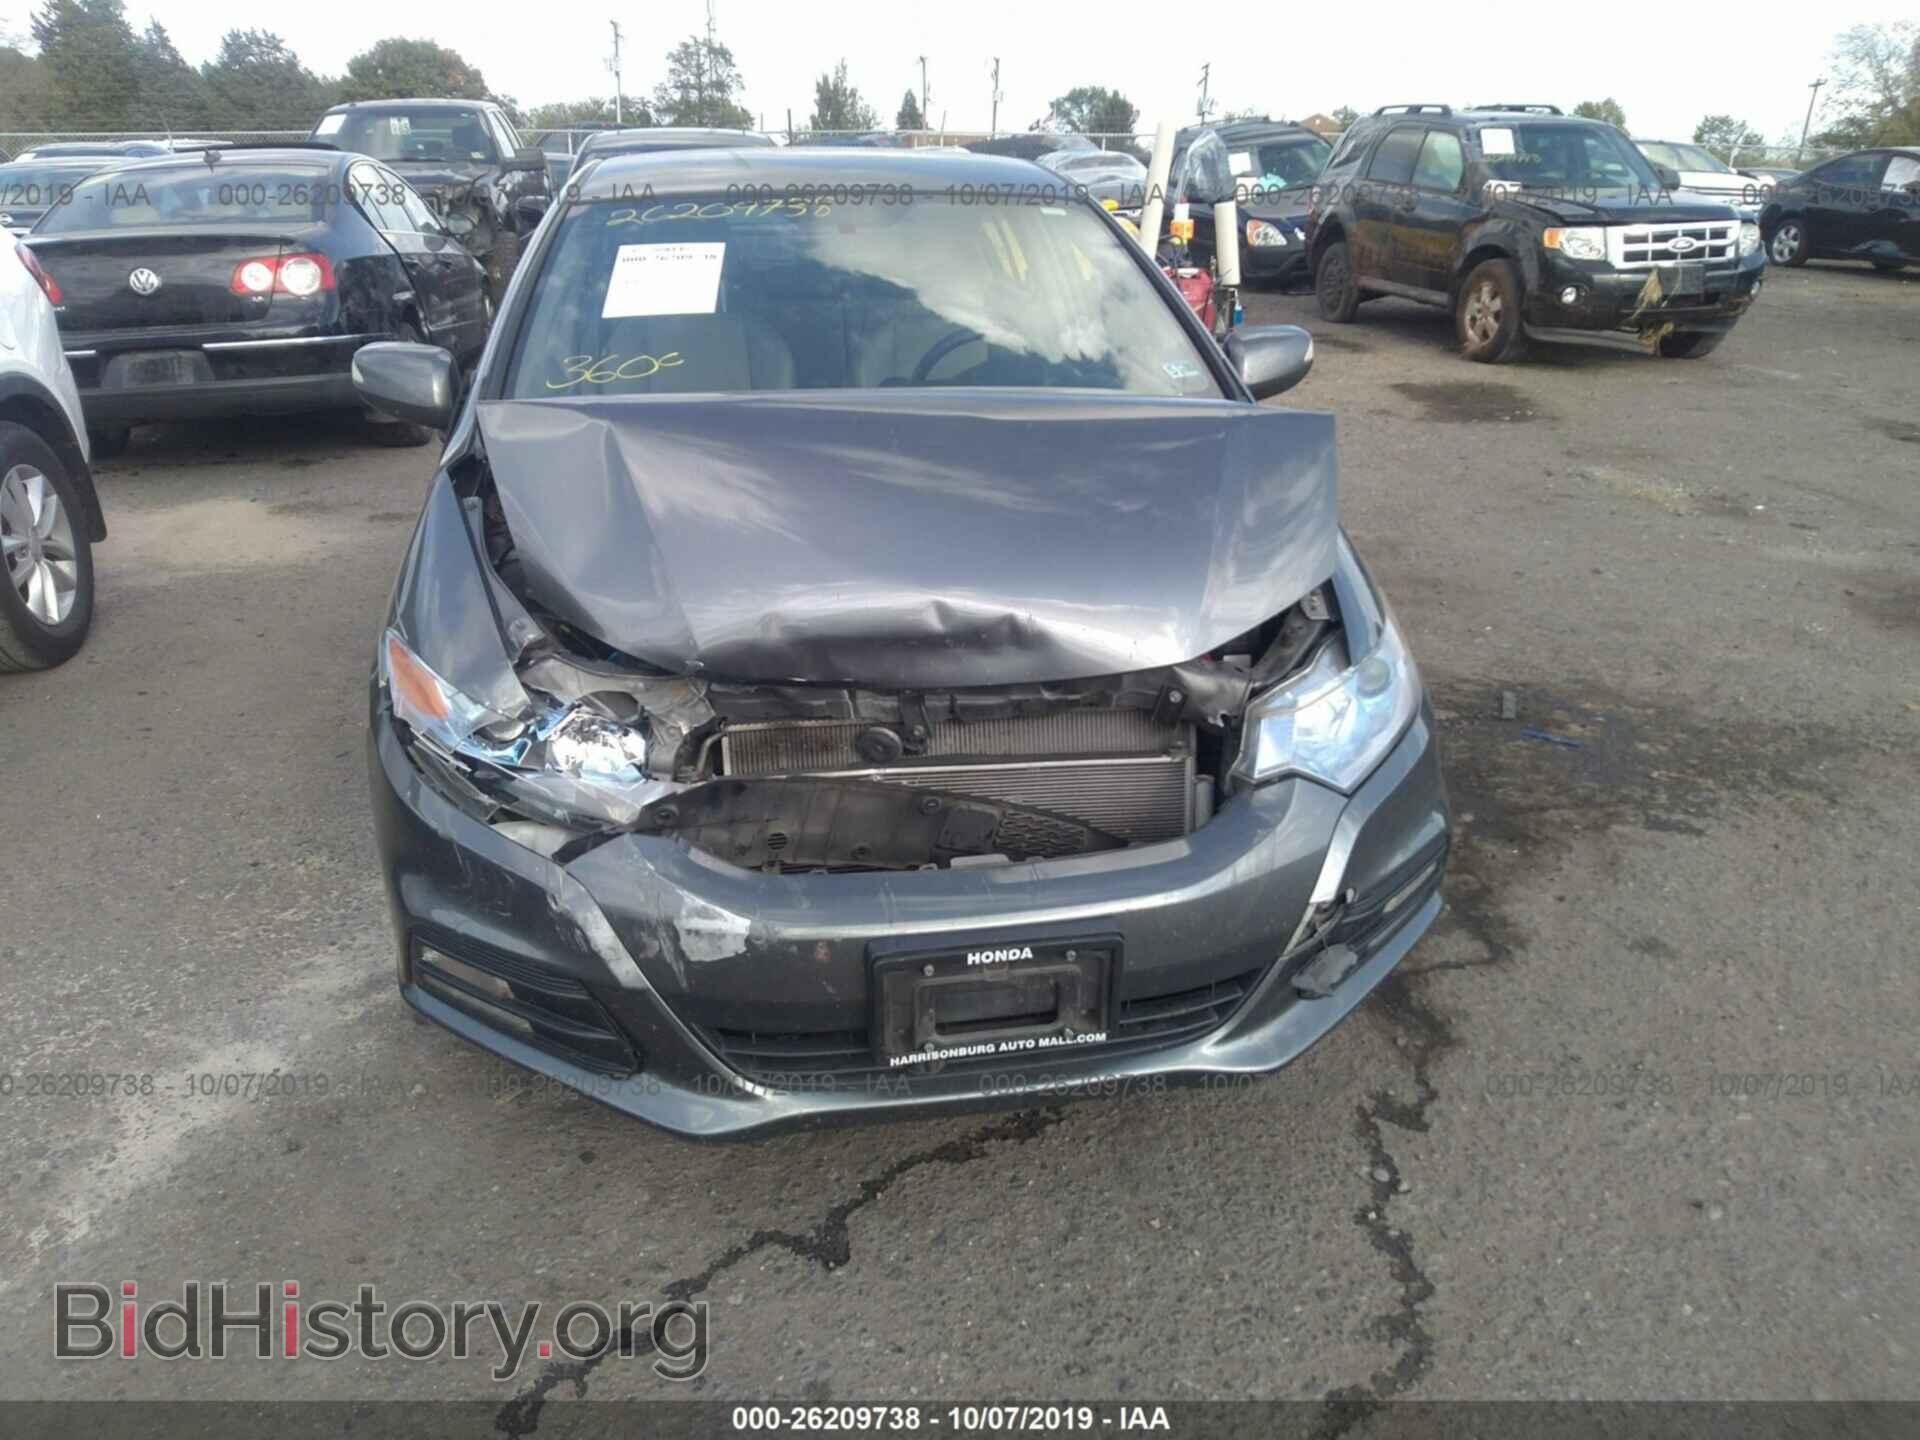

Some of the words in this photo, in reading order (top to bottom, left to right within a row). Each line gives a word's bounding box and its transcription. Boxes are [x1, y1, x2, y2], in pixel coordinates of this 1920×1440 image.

[967, 947, 1033, 965] HONDA
[890, 1043, 995, 1067] HARRISONBURG
[999, 1039, 1036, 1051] AUTO
[1038, 1032, 1107, 1047] MALL.COM
